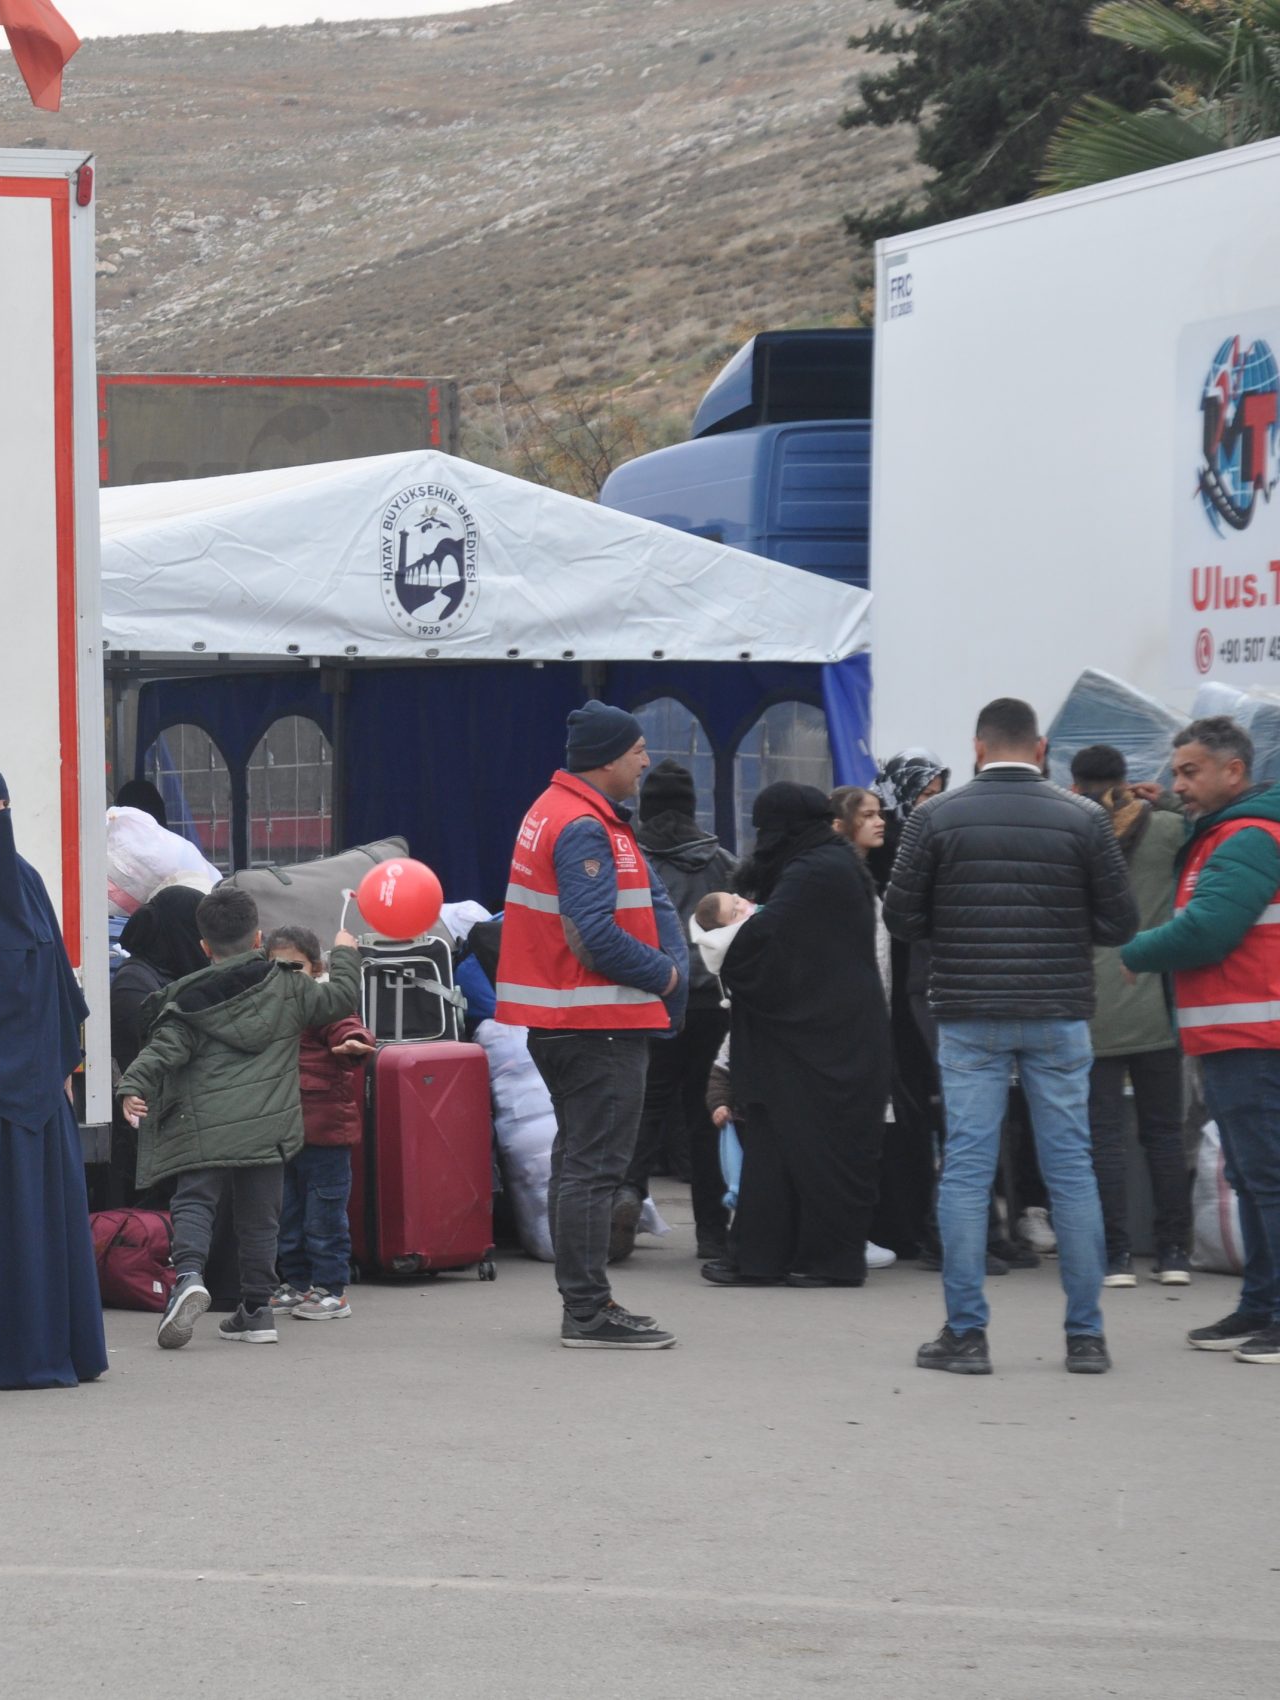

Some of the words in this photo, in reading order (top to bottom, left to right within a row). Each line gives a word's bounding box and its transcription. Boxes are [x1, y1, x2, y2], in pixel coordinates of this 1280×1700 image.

[890, 273, 913, 301] FRC
[382, 536, 393, 581] HATAY
[417, 625, 441, 635] 1939
[1218, 638, 1241, 664] +90
[1243, 637, 1266, 663] 507
